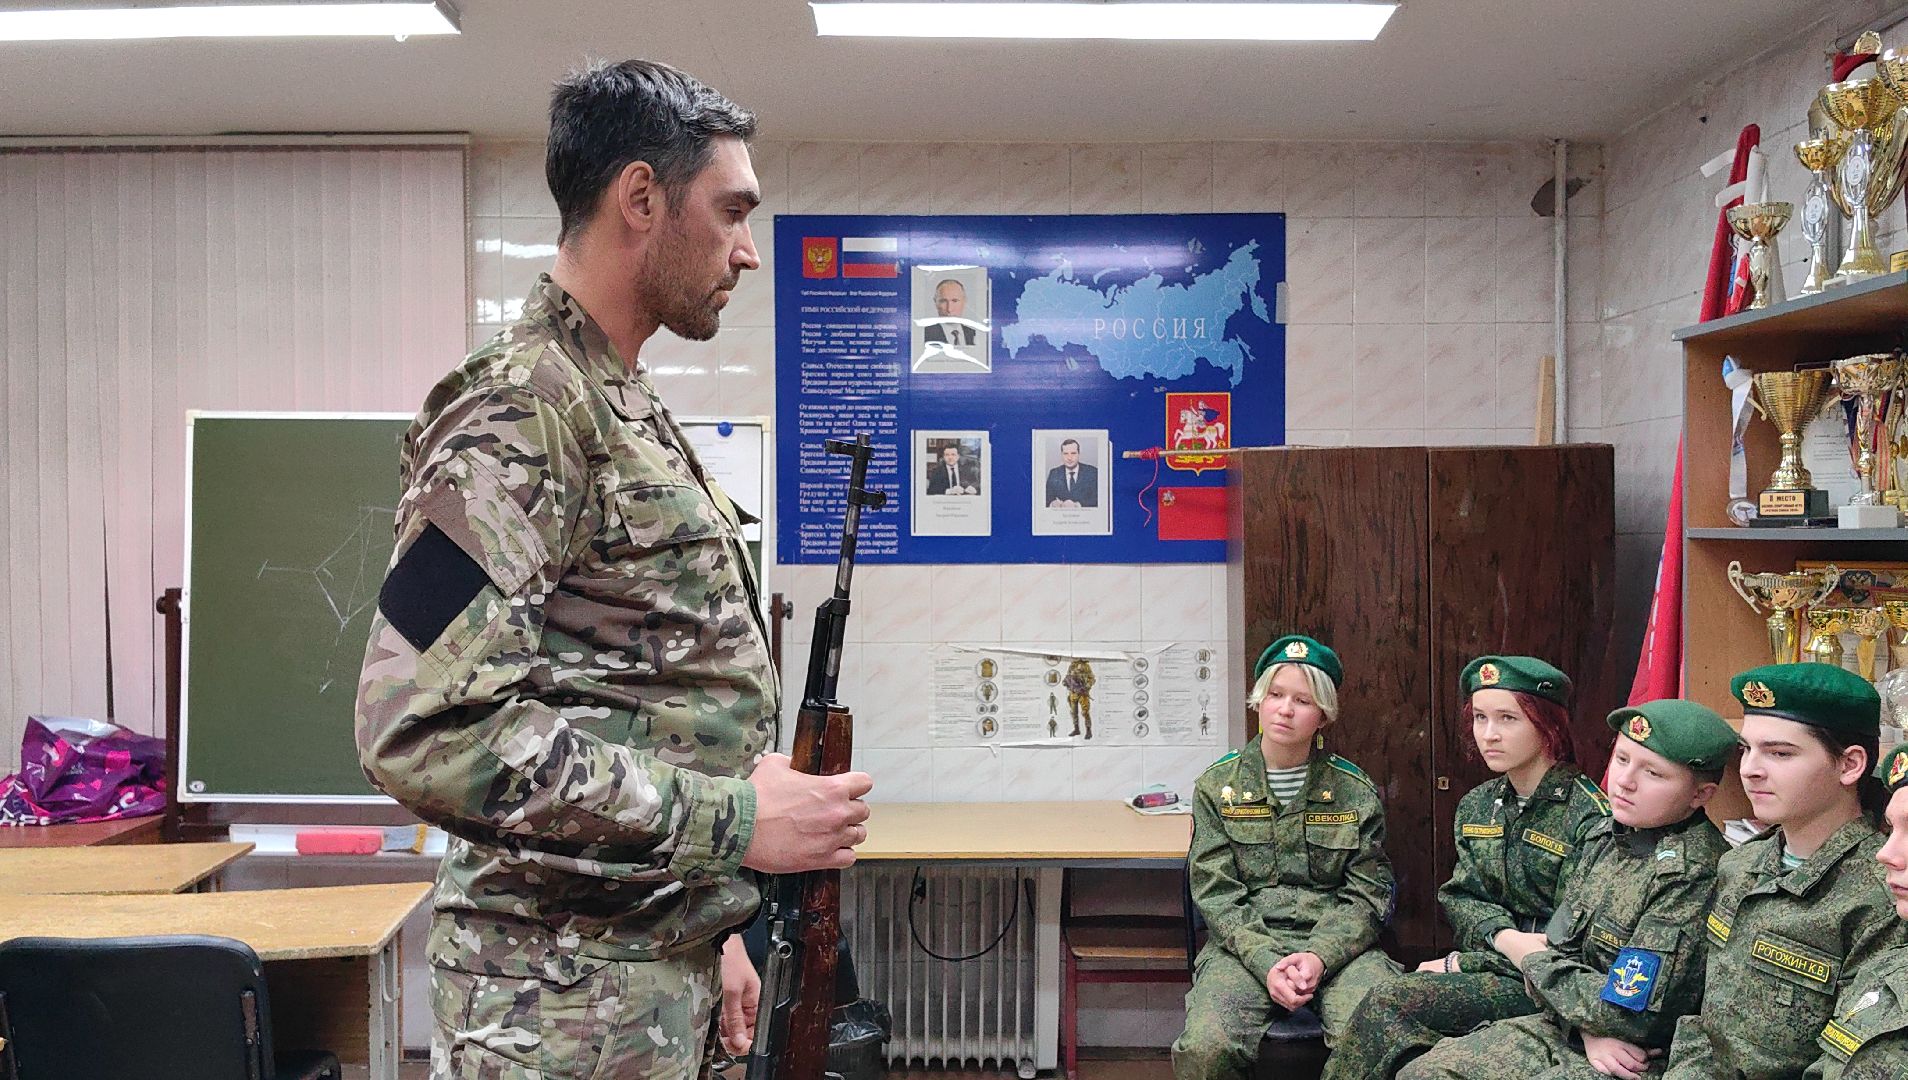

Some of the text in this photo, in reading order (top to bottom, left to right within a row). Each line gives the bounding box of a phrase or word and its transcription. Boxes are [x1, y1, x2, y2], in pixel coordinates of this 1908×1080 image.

[1094, 318, 1206, 340] РОССИЯ
[1757, 944, 1826, 978] РОГОЖИН К.В.
